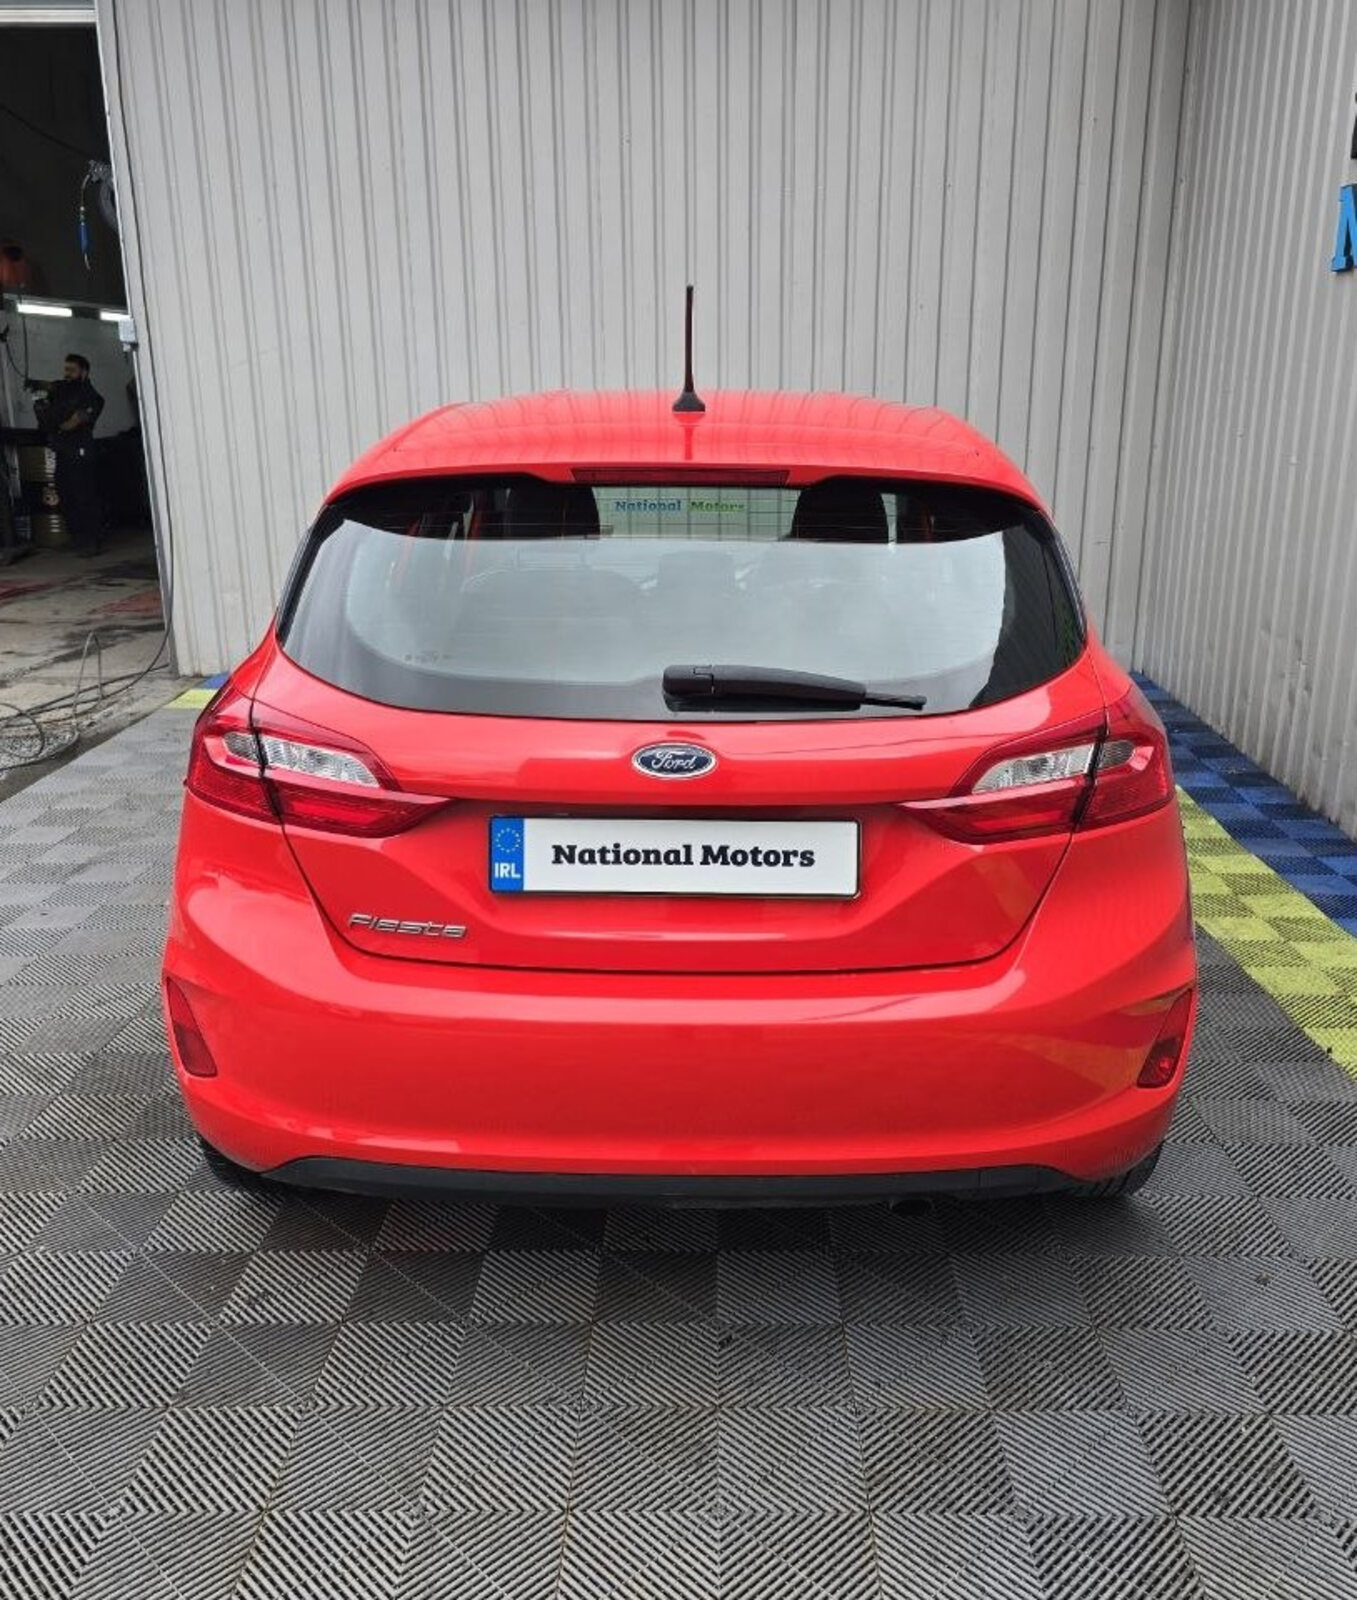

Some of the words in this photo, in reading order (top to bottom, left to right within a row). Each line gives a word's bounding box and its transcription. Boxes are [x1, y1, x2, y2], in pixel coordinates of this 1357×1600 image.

[615, 499, 681, 511] National
[690, 501, 745, 512] Motors
[651, 750, 697, 769] Ford
[552, 843, 693, 866] National
[700, 845, 815, 868] Motors
[494, 861, 521, 879] IRL
